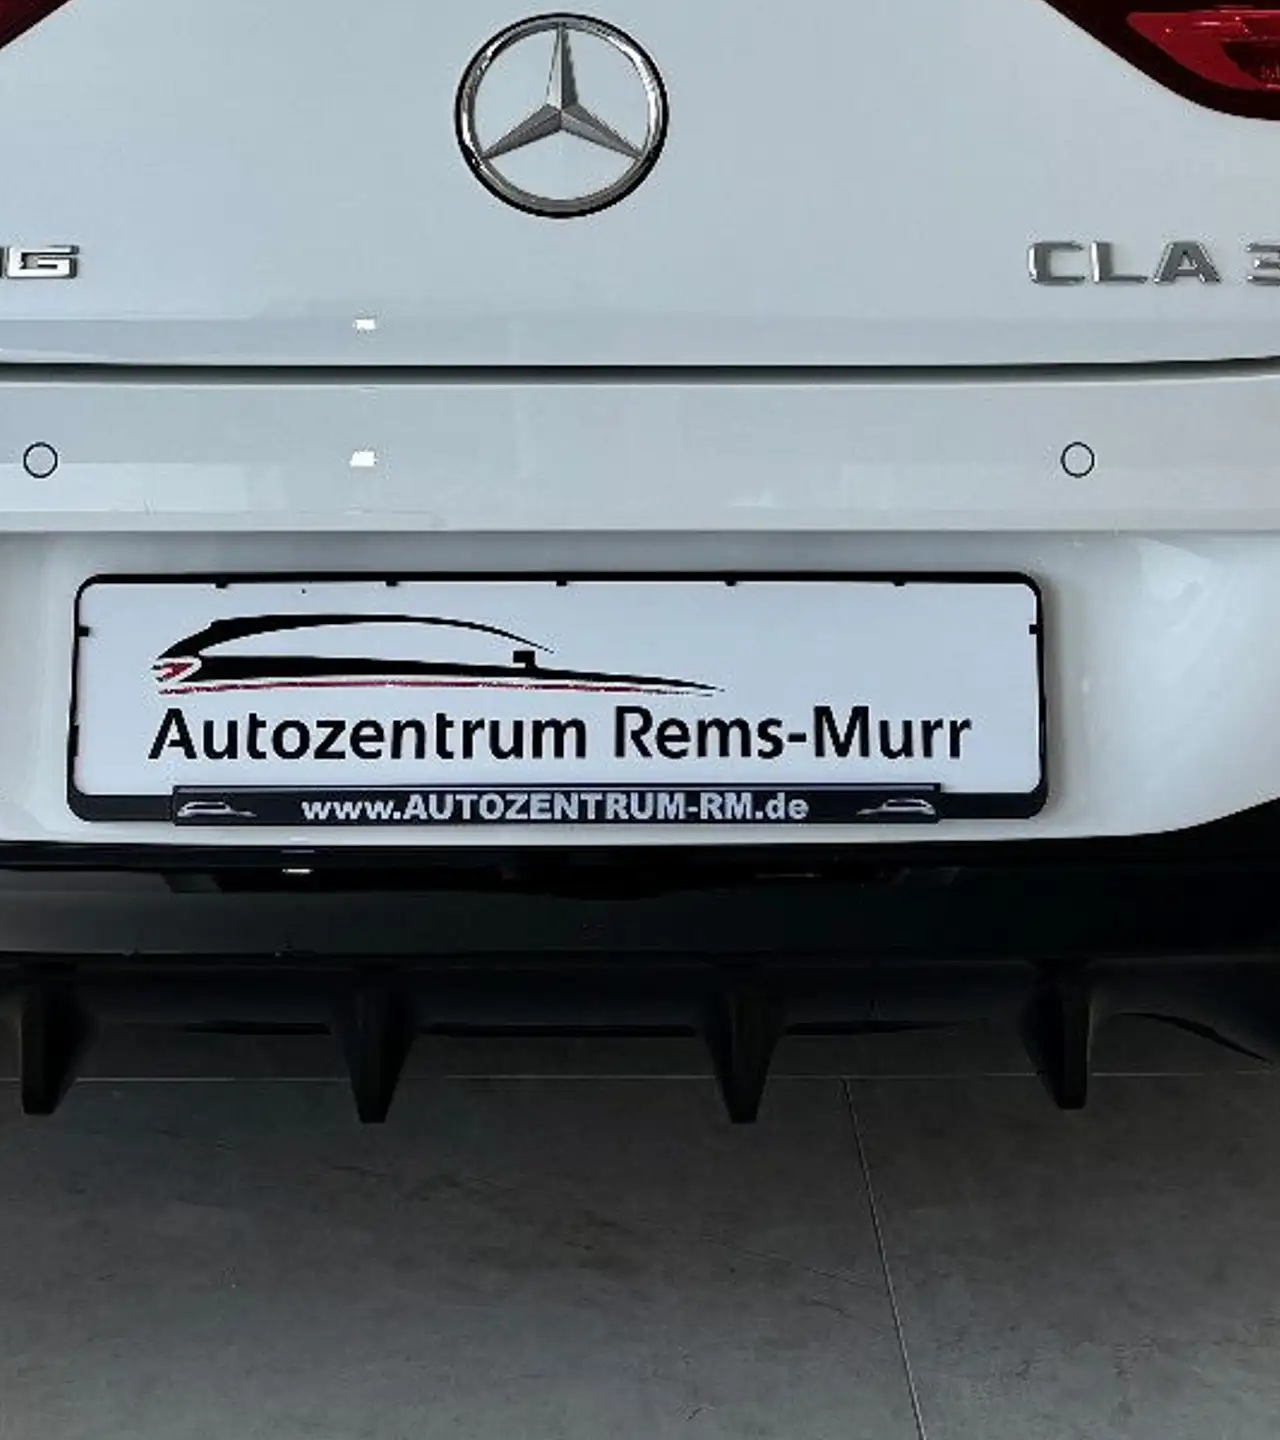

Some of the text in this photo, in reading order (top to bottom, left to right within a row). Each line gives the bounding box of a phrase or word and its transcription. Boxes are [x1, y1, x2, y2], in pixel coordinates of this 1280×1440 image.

[1027, 241, 1222, 285] CLA
[148, 706, 974, 762] Autozentrum Rems-Murr
[300, 791, 810, 823] www.AUTOZENTRUM-RM.de
